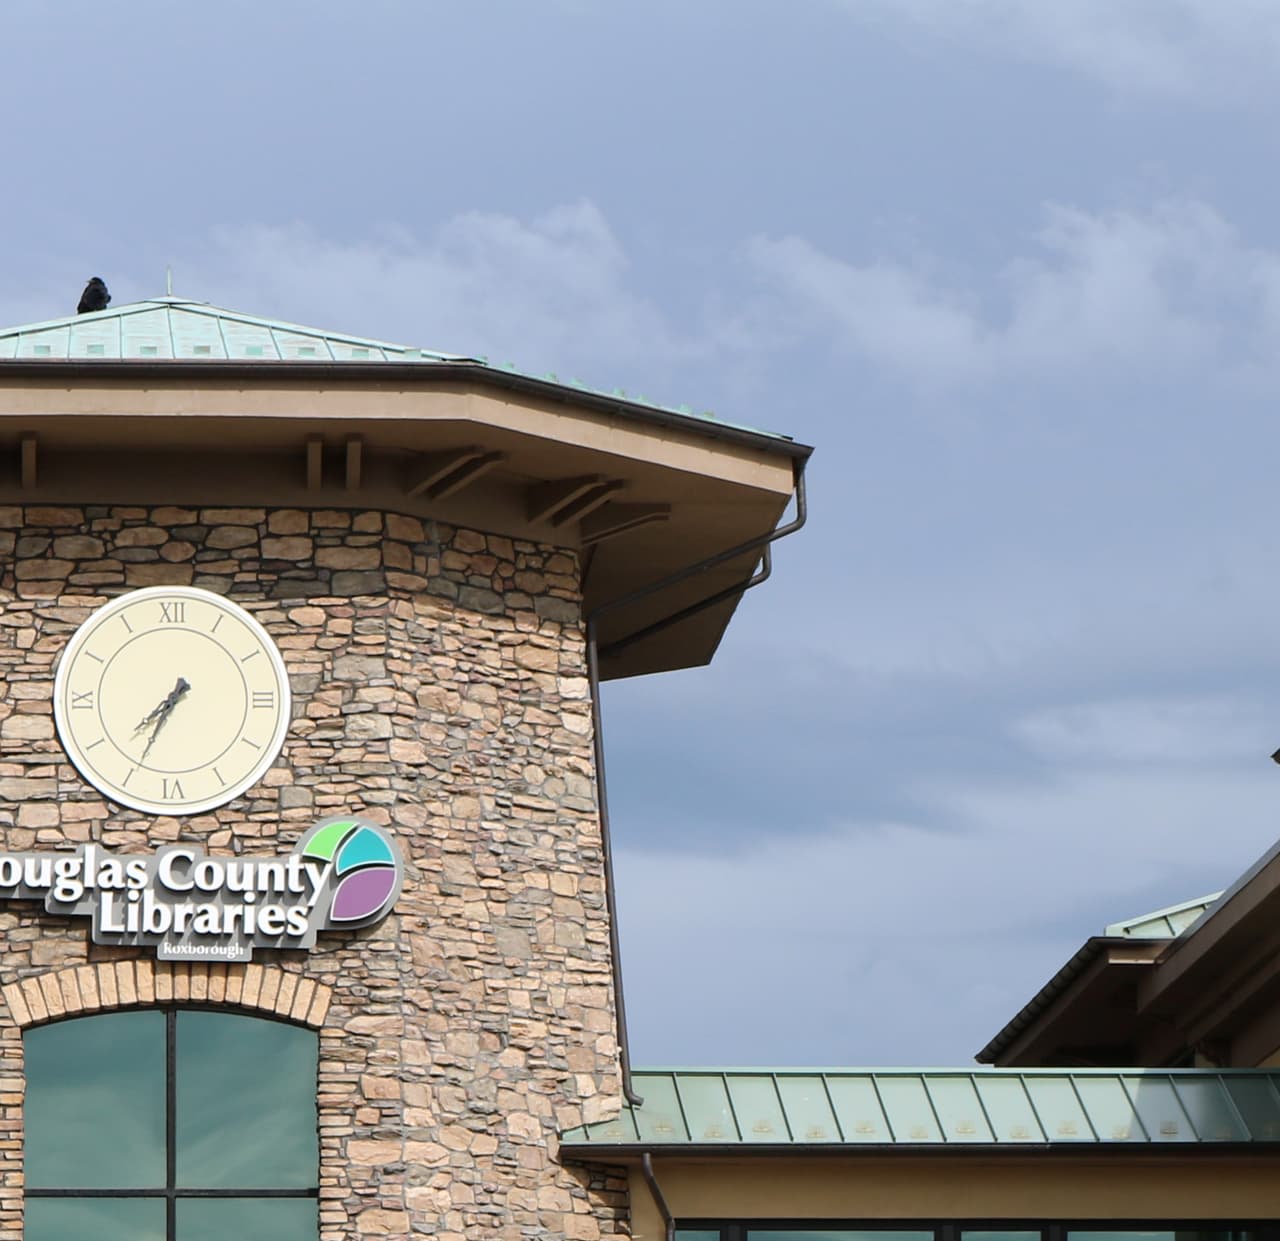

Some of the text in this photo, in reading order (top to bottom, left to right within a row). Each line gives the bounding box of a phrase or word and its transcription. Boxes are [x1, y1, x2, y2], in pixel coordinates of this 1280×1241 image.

[159, 602, 186, 623] XII
[158, 850, 332, 906] County
[100, 889, 309, 935] Libraries
[163, 942, 244, 959] Roxborough
